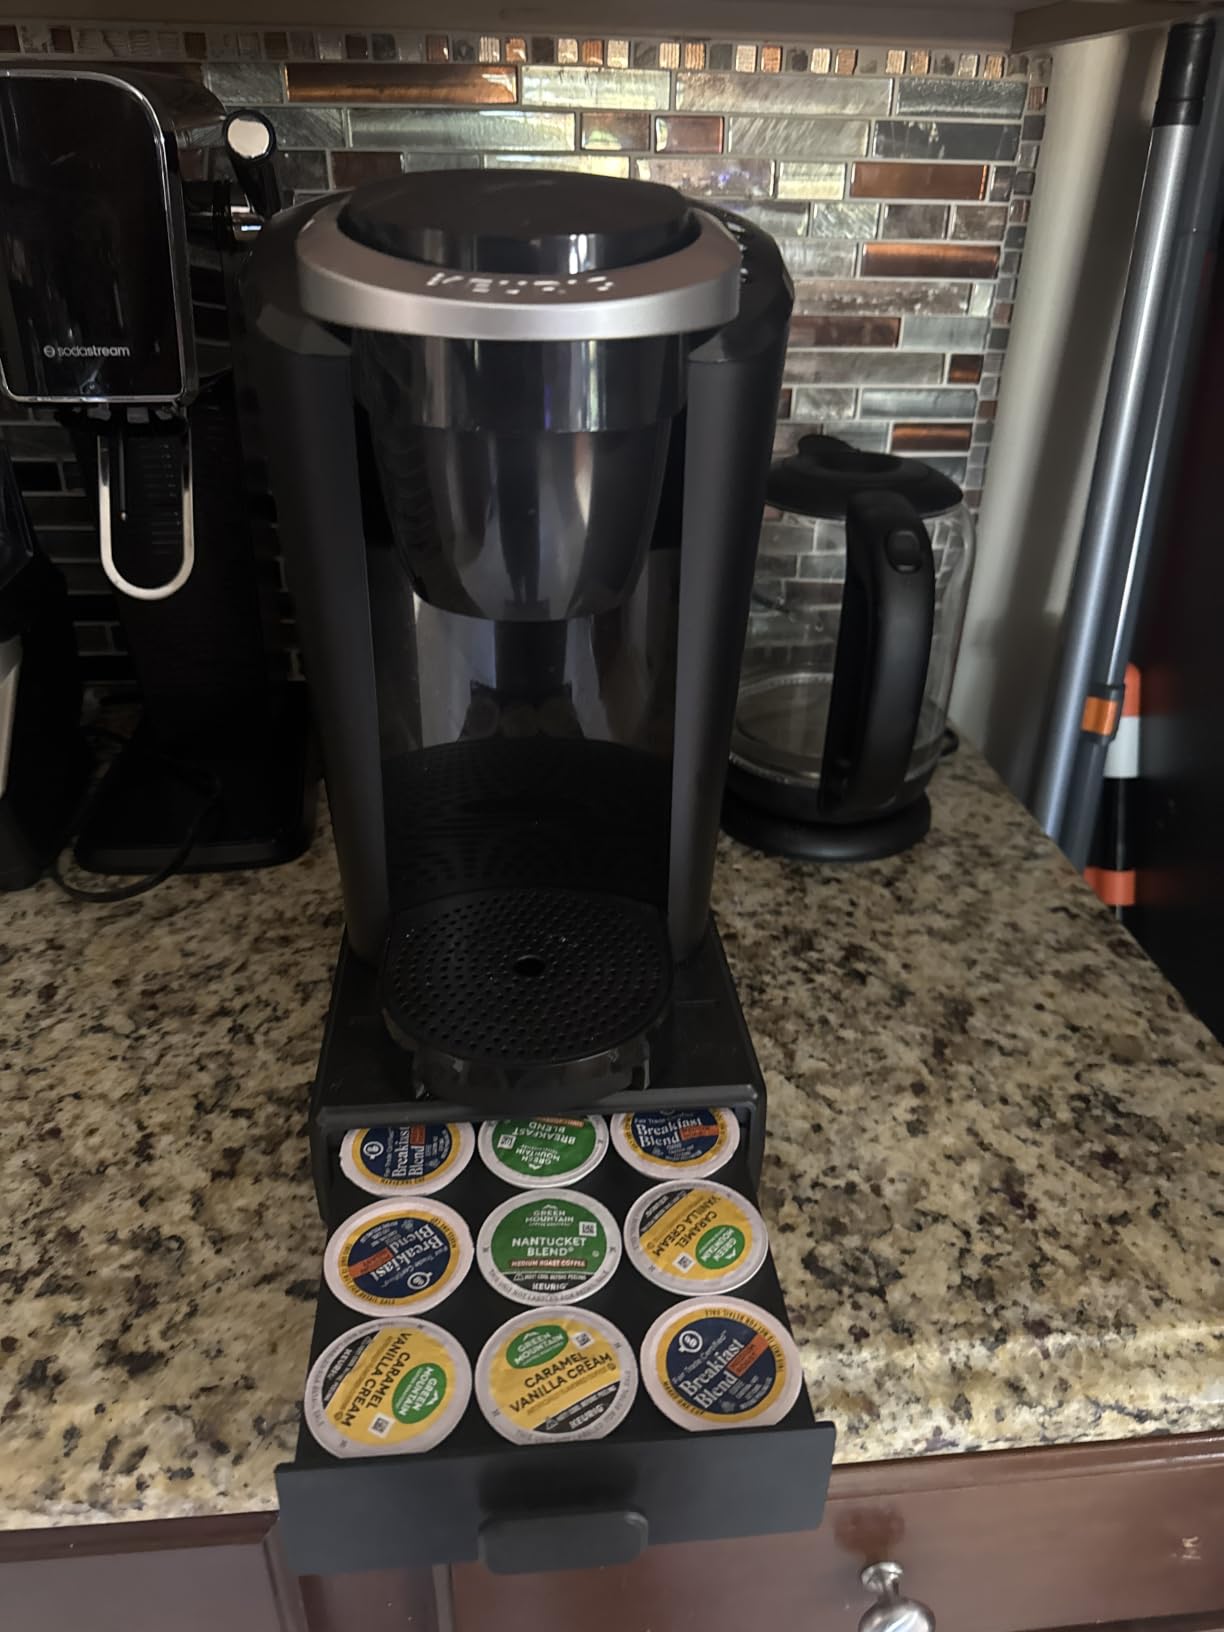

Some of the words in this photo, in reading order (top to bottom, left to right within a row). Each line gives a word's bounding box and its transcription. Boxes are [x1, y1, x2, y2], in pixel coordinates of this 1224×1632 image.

[57, 345, 131, 357] sodastream
[512, 1127, 577, 1145] BREAKFAST
[528, 1121, 566, 1133] BLEND
[635, 1118, 702, 1136] Breakfast
[638, 1131, 681, 1148] Blend
[408, 1145, 425, 1176] Blend
[683, 1194, 721, 1225] VANILLA
[388, 1224, 434, 1254] Blend
[511, 1237, 587, 1248] NANTUCKET
[652, 1223, 687, 1257] CREAM
[674, 1210, 718, 1249] CARAMEL
[370, 1235, 444, 1281] Breakfast
[371, 1332, 412, 1377] VANILLA
[514, 1333, 564, 1365] MOUNTAIN
[517, 1331, 551, 1352] GREEN
[365, 1351, 411, 1410] CARAMEL
[509, 1375, 567, 1413] VANILLA
[566, 1352, 613, 1380] CREAM
[524, 1351, 588, 1389] CARAMEL
[678, 1337, 745, 1397] Breakfast
[340, 1379, 377, 1427] CREAM
[397, 1366, 434, 1416] MOUNTAIN
[412, 1378, 438, 1411] GREEN
[692, 1370, 738, 1409] Blend
